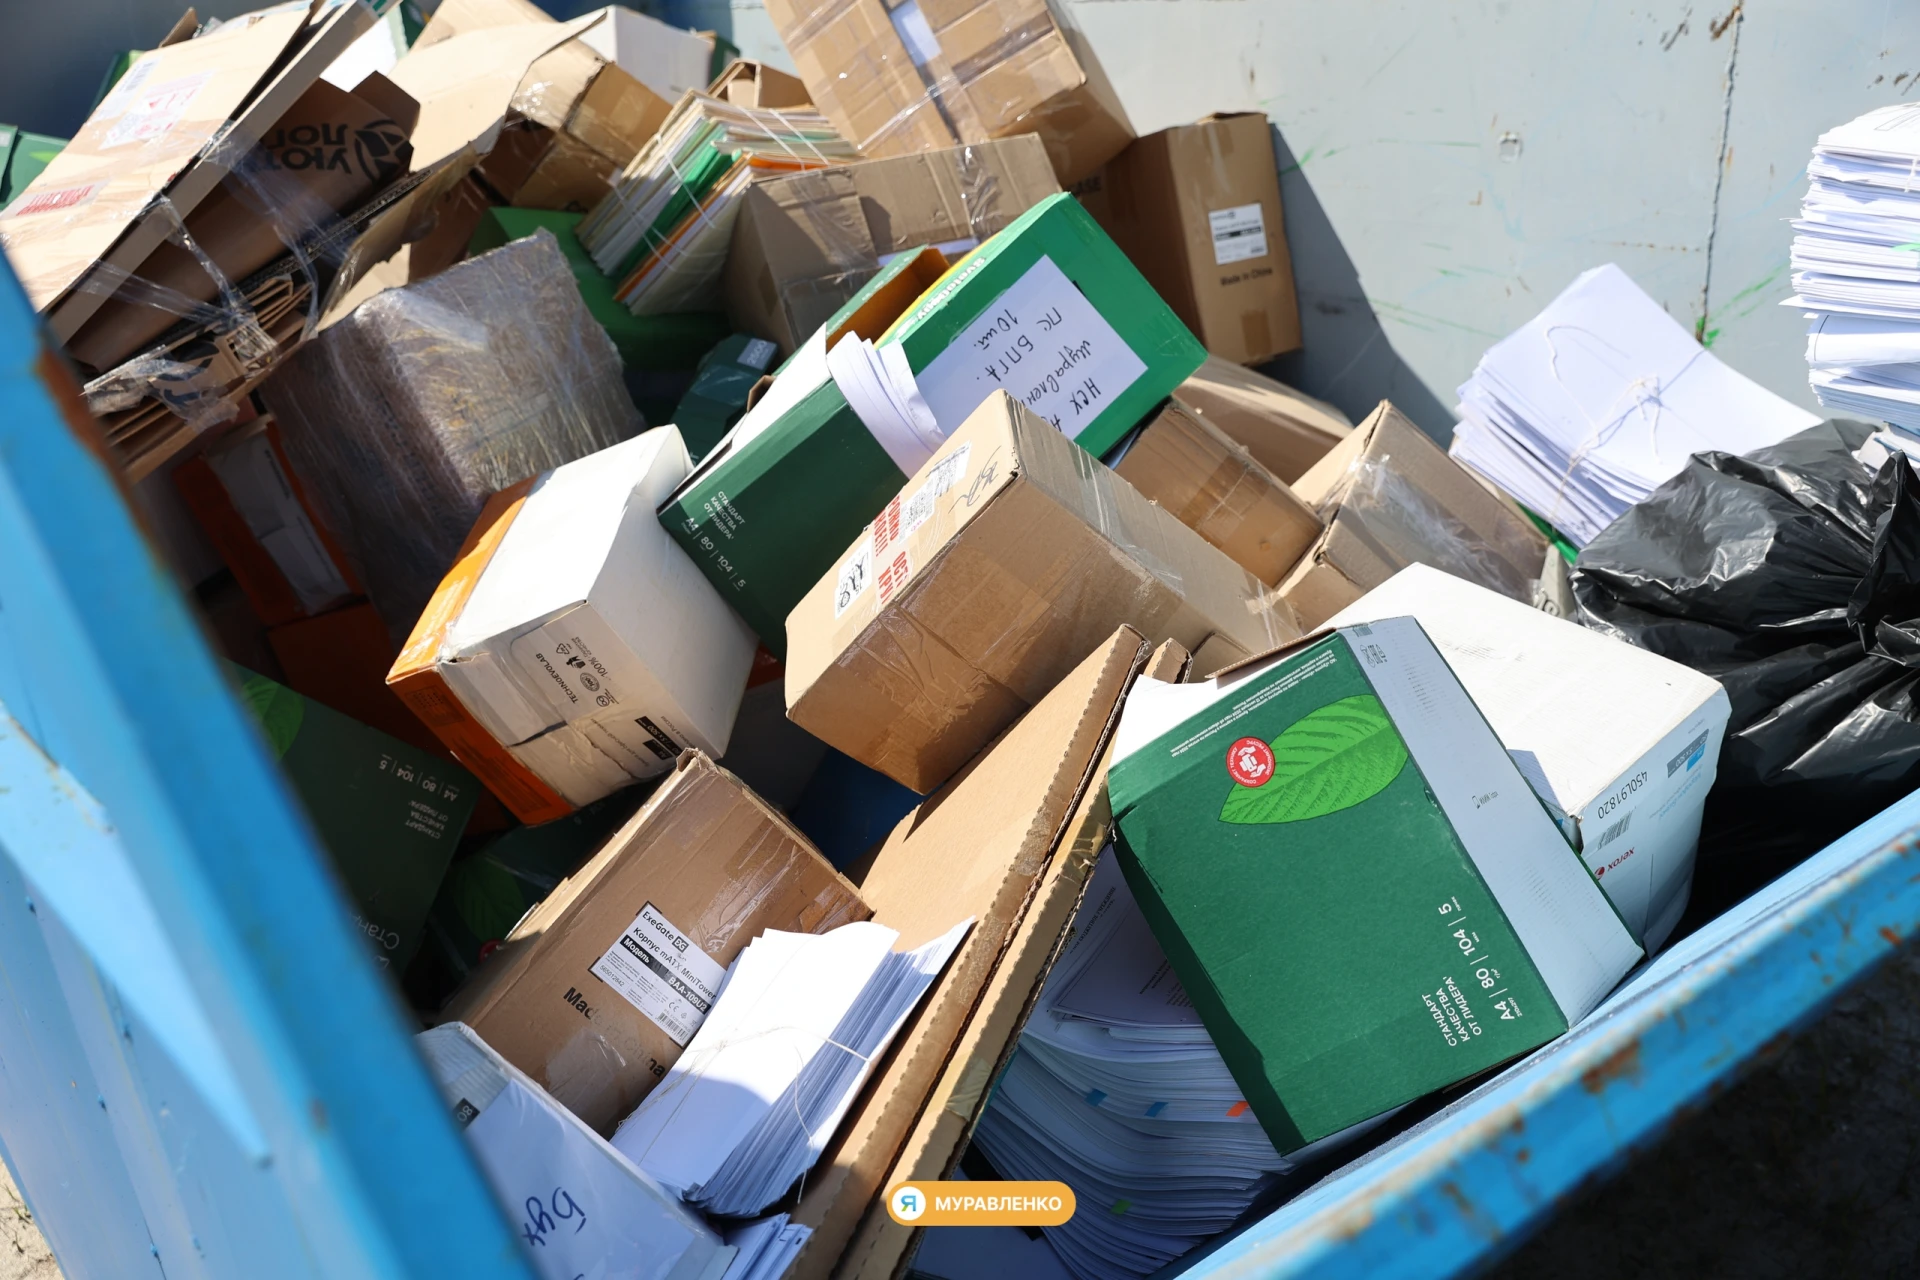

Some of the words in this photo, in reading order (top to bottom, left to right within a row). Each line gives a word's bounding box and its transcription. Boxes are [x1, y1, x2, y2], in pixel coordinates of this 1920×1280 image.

[702, 501, 713, 513] ОТ
[708, 496, 739, 530] КАЧЕСТВА
[715, 490, 747, 525] СТАНДАРТ
[684, 515, 700, 531] A4
[700, 535, 714, 551] 80
[716, 554, 733, 572] 104
[736, 578, 746, 587] 5
[535, 650, 578, 704] TECHNOEVOLAB
[378, 759, 387, 769] 5
[395, 767, 415, 782] 104
[421, 779, 437, 792] 80
[1598, 771, 1648, 819] 450L91820
[1607, 847, 1635, 871] xerox
[1437, 901, 1453, 916] 5
[640, 910, 676, 941] ExeGate
[1452, 927, 1476, 957] 104
[622, 937, 652, 963] Модель
[666, 977, 708, 1011] BAA-109U2
[630, 927, 662, 954] Корпус
[658, 949, 682, 970] mATX
[678, 967, 718, 1000] MiniTower
[1474, 965, 1495, 990] 80
[1421, 990, 1459, 1047] СТАНДАРТ
[1434, 987, 1470, 1042] КАЧЕСТВА
[1493, 999, 1514, 1024] A4
[1467, 1018, 1482, 1036] ОТ
